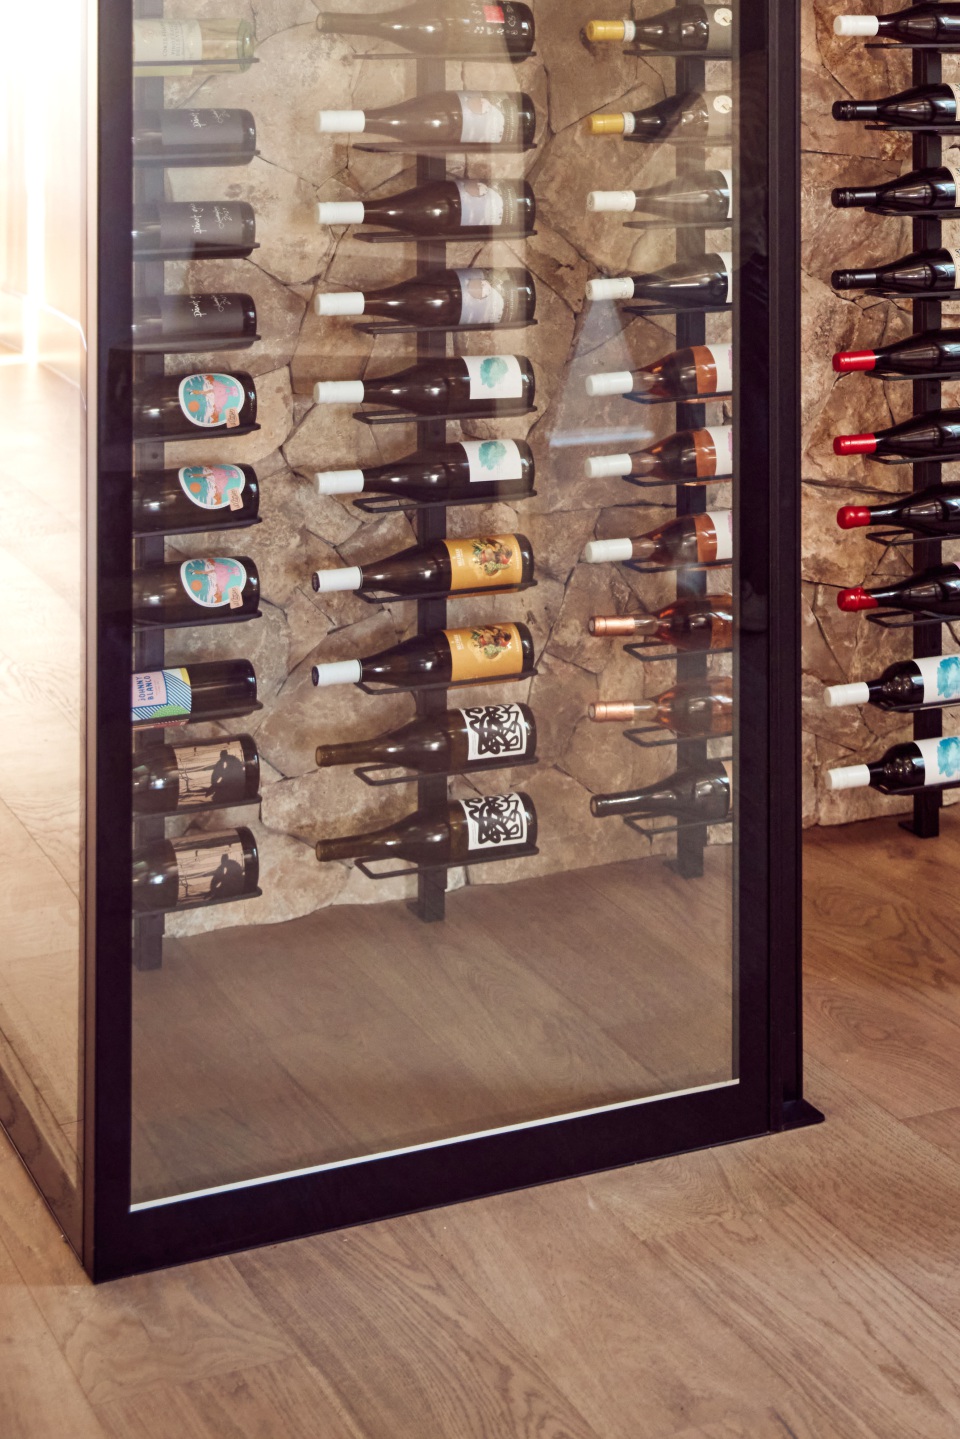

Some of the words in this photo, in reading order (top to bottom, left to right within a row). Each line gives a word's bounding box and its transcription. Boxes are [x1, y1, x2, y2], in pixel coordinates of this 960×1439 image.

[190, 215, 207, 234] pinot
[136, 676, 146, 702] JOHNNY
[144, 676, 154, 700] BLANCO
